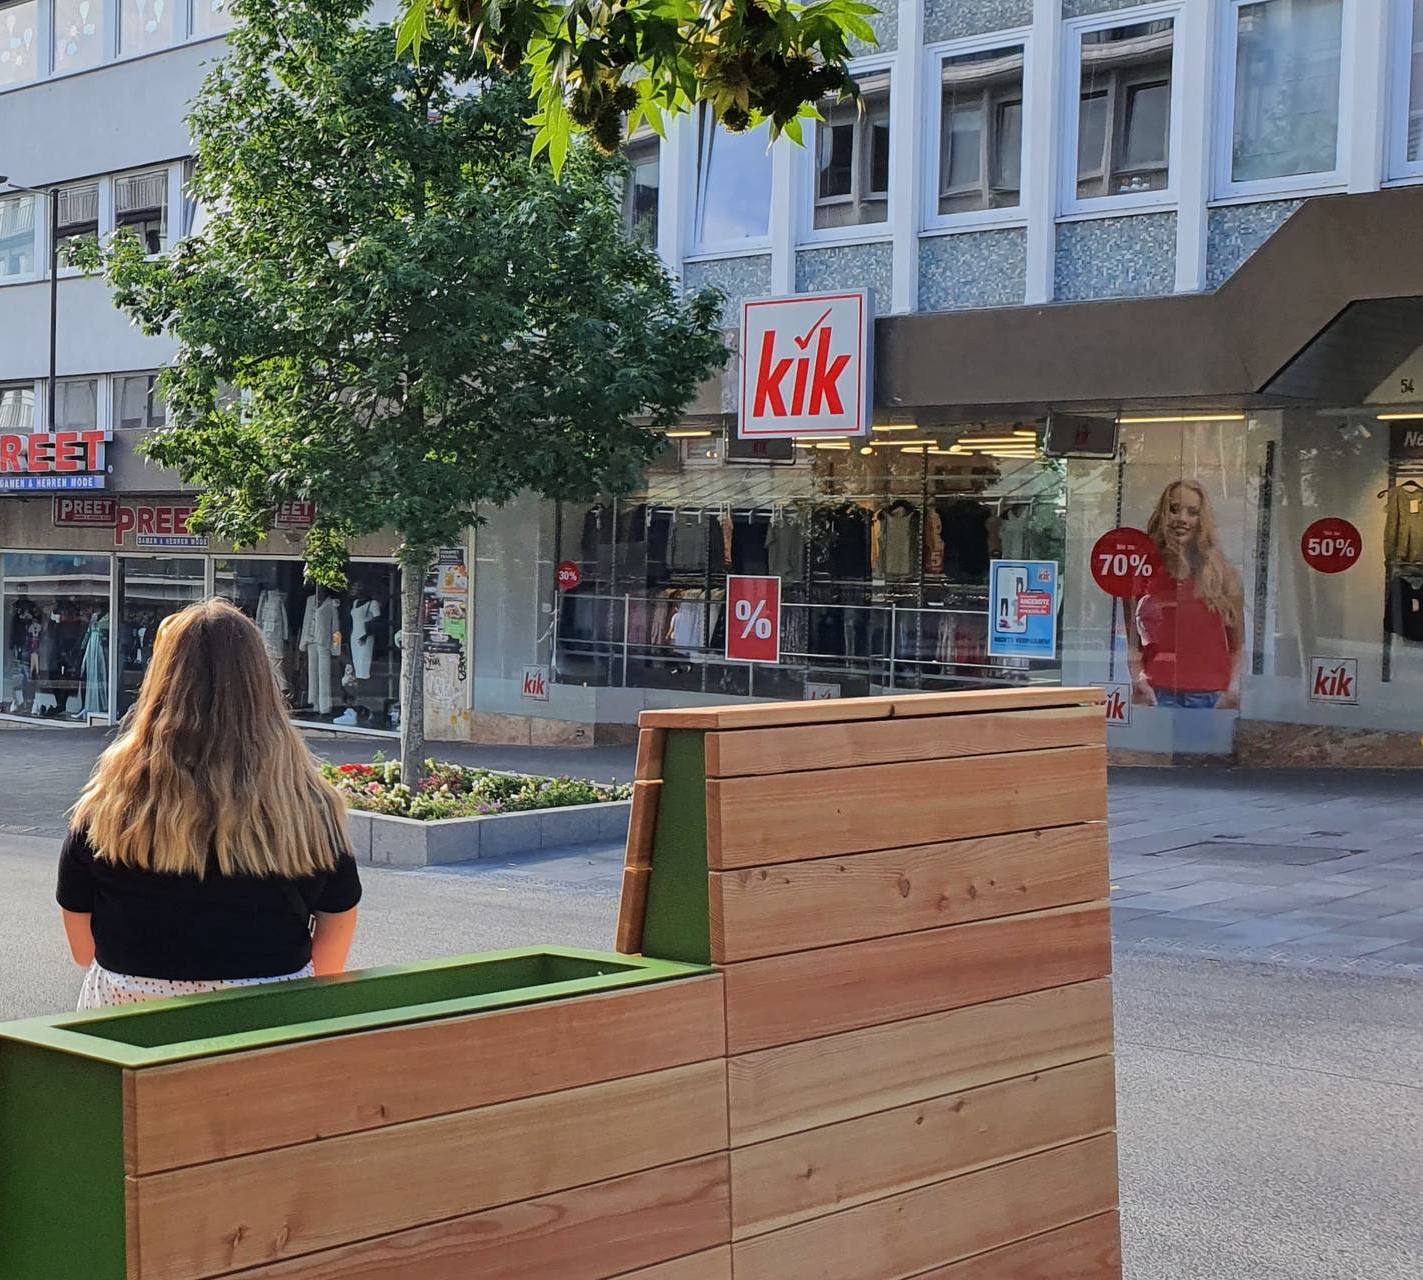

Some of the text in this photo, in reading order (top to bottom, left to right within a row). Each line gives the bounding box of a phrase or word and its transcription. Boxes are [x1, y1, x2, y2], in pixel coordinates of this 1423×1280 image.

[752, 307, 852, 418] kik
[1400, 378, 1415, 394] 54
[0, 477, 27, 489] DAMEN
[36, 477, 68, 489] HERREN
[70, 477, 94, 488] MODE
[61, 499, 112, 519] PREET
[115, 506, 200, 546] PREE
[1307, 538, 1355, 557] 50%
[558, 570, 578, 582] 30%
[1099, 553, 1153, 577] 70%
[735, 599, 772, 639] %
[523, 669, 545, 695] kik
[1313, 662, 1353, 697] kik
[1105, 687, 1126, 719] ik
